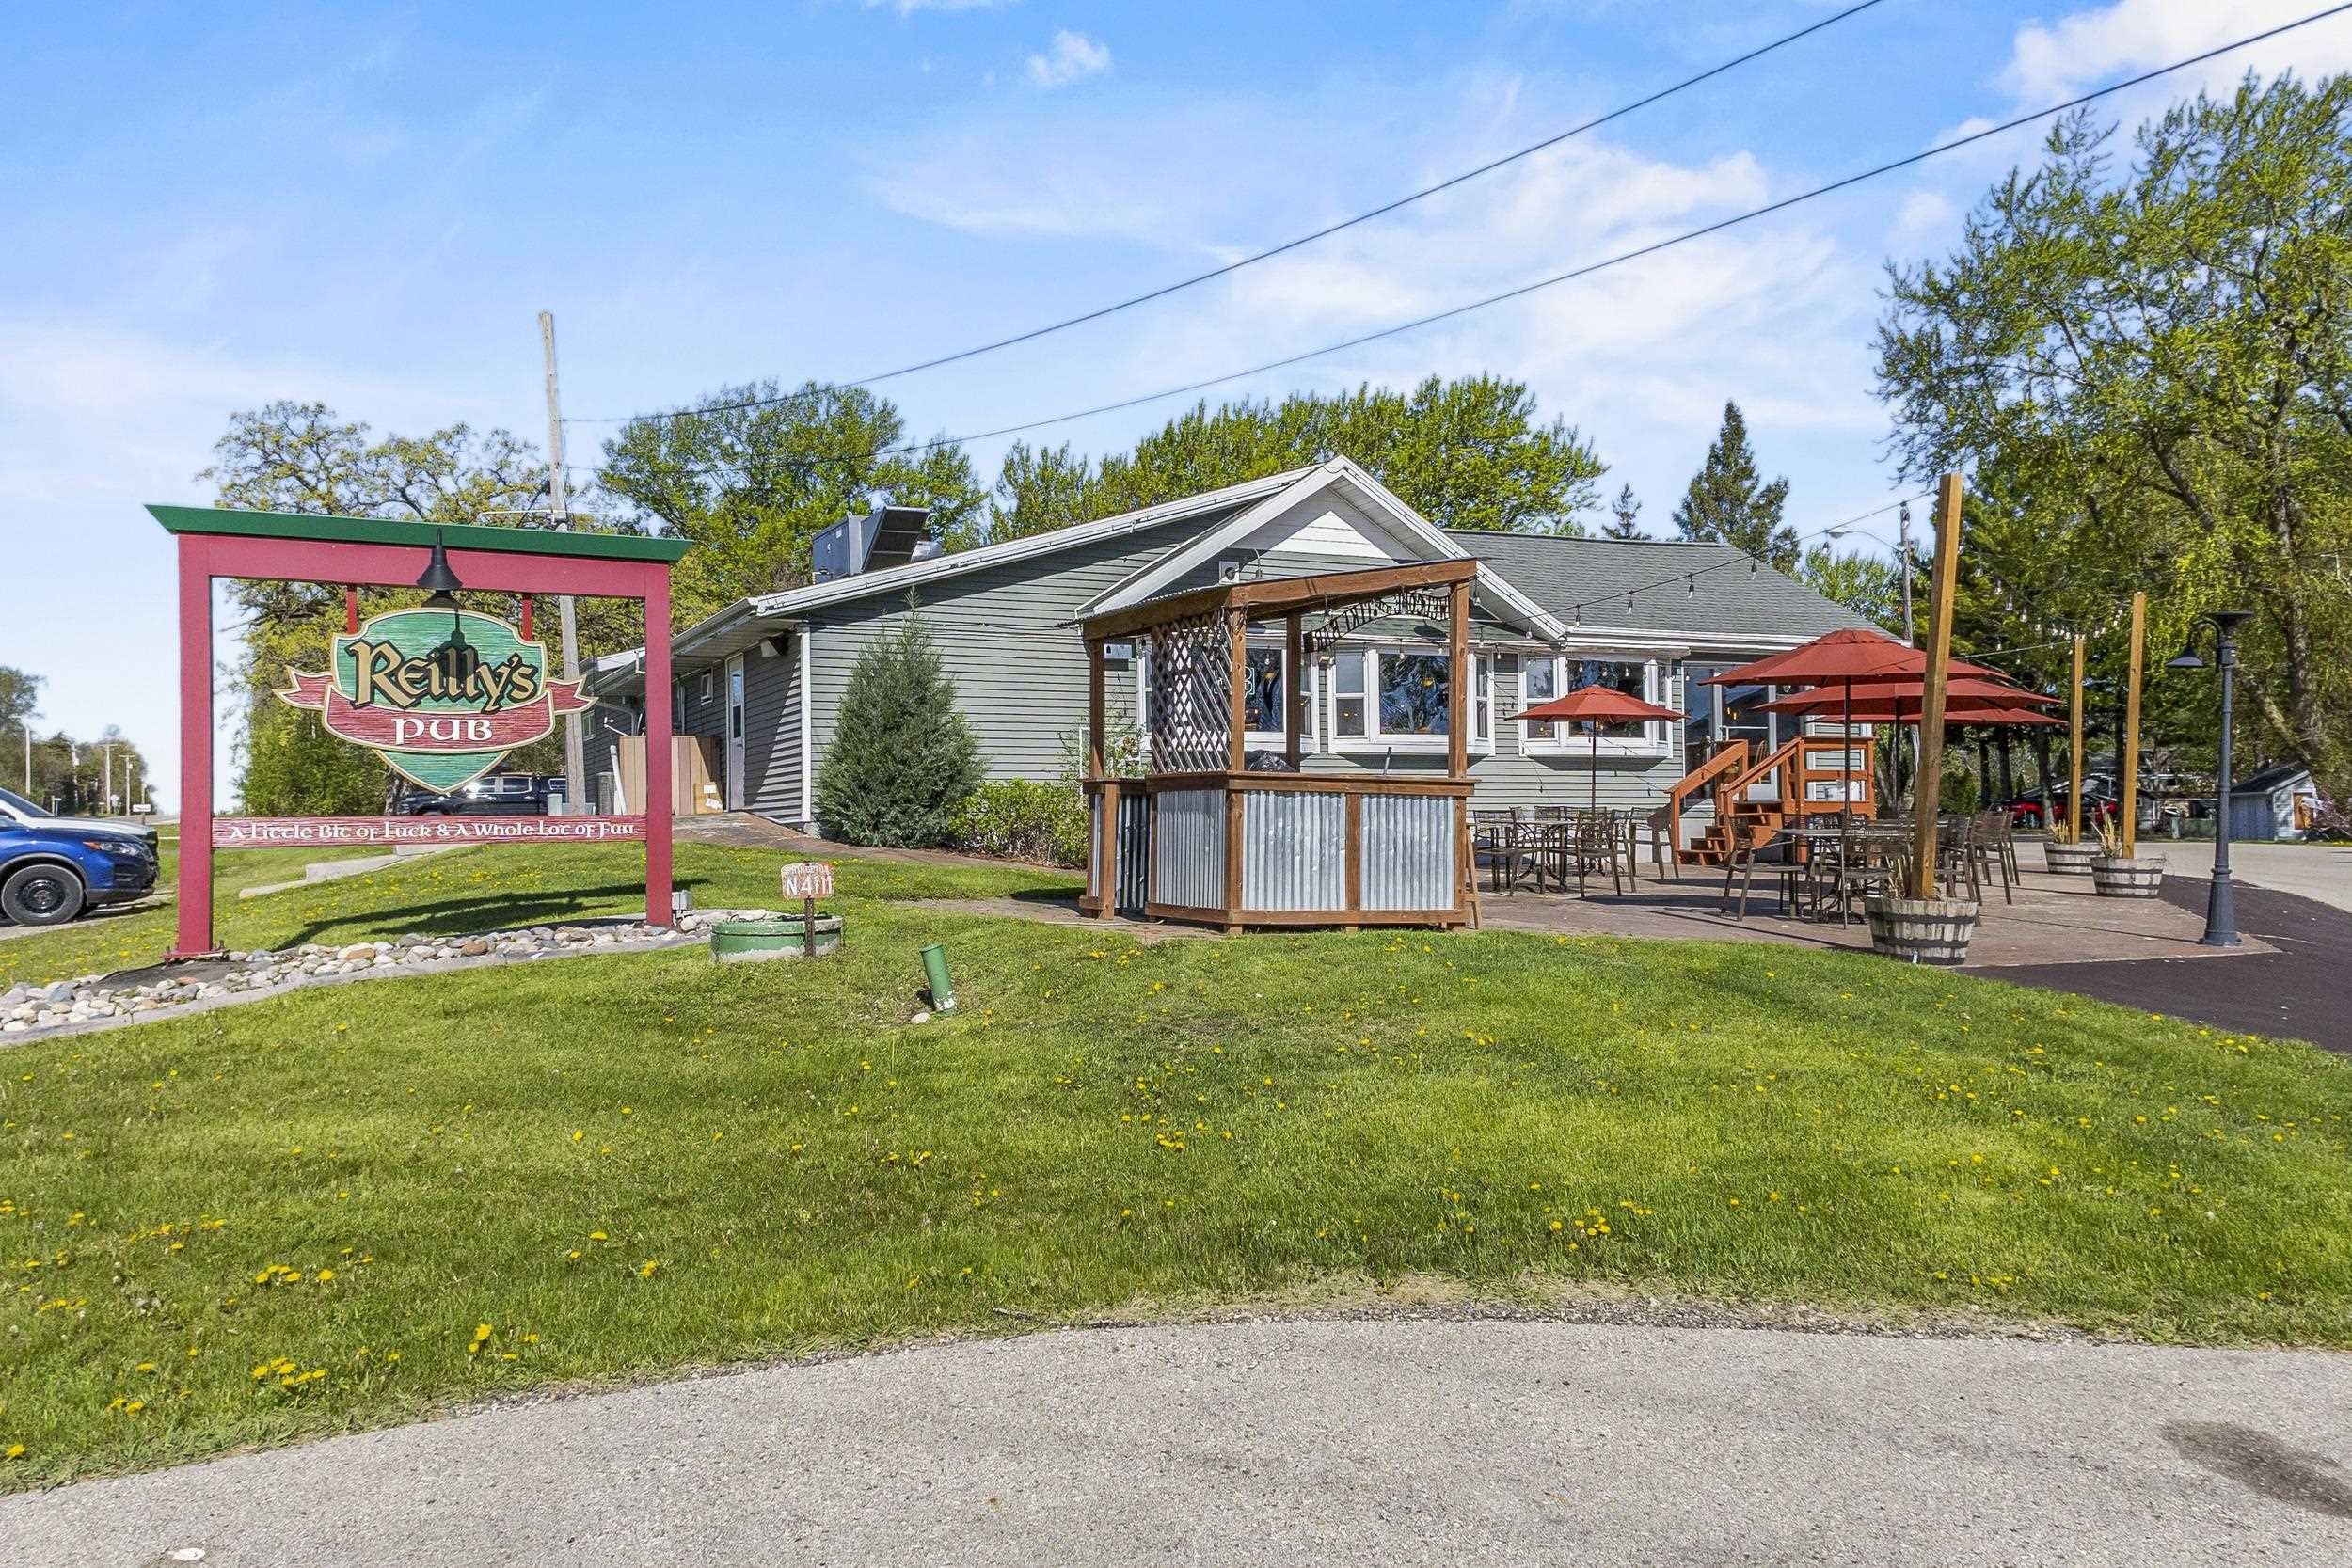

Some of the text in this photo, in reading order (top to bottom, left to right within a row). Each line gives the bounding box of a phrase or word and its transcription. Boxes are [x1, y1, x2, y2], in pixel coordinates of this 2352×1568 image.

[345, 640, 537, 713] Reilly's
[230, 820, 635, 840] A Little Bit of Luck & A Whole Lot of Fun
